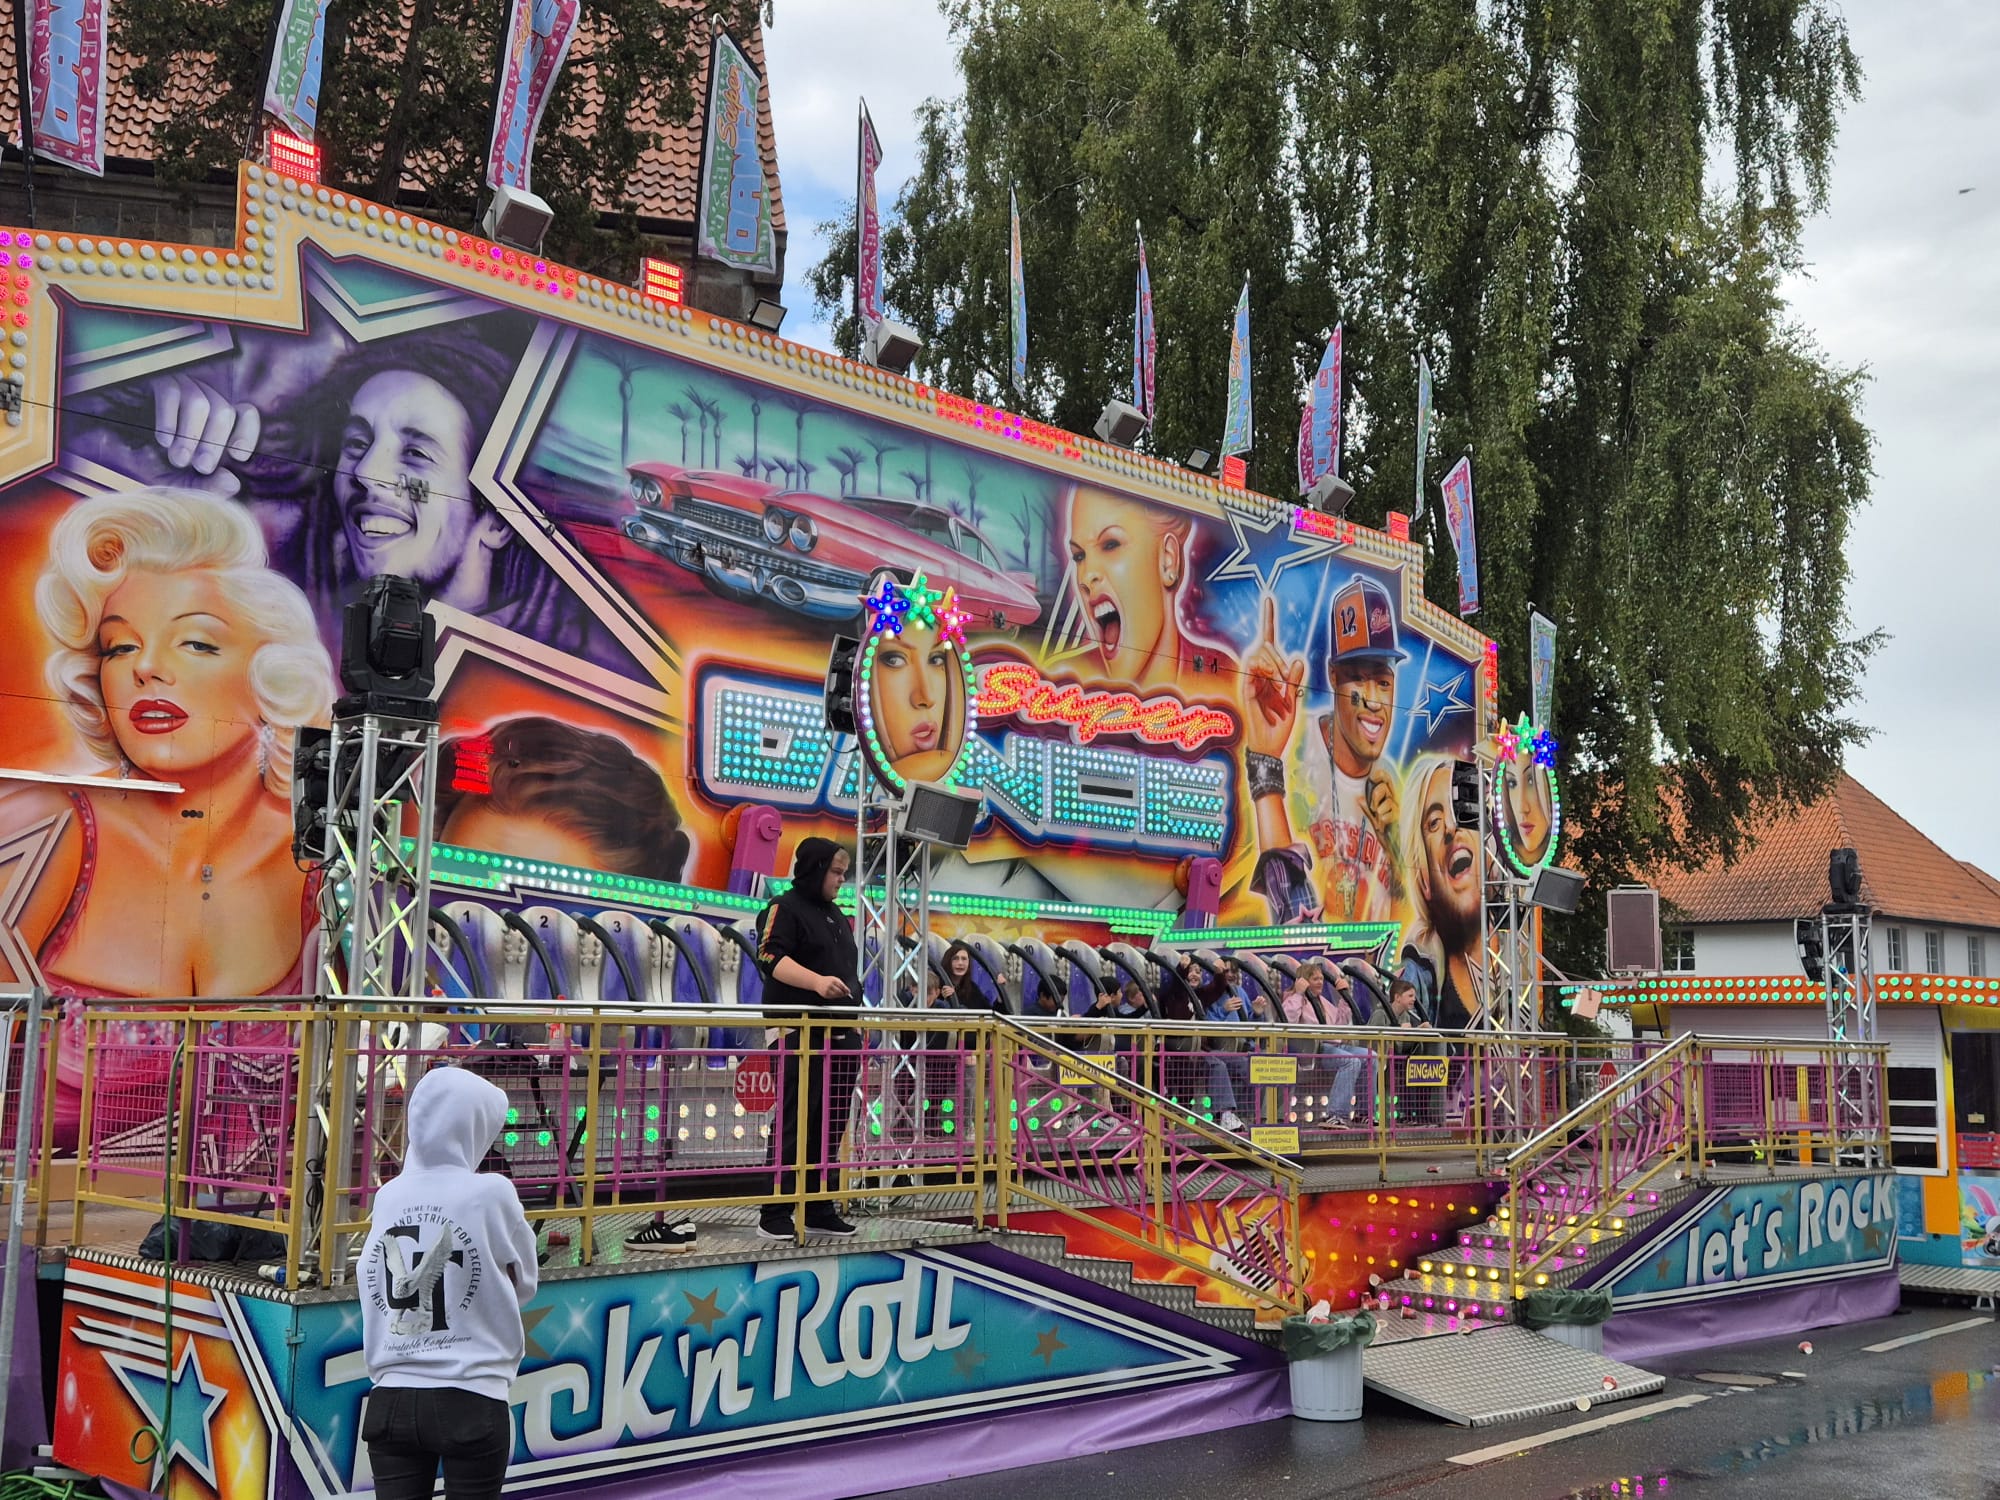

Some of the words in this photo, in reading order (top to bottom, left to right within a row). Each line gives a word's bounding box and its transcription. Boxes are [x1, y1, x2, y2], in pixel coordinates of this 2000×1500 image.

[1341, 606, 1357, 635] 12
[974, 662, 1235, 748] Super
[712, 688, 1227, 842] DNCE
[463, 911, 470, 923] 1
[540, 915, 549, 929] 2
[613, 920, 622, 933] 3
[683, 923, 692, 936] 4
[749, 928, 756, 941] 5
[1024, 944, 1034, 956] 10
[1408, 1063, 1445, 1080] EINGANG
[403, 1205, 423, 1215] CRIME
[427, 1204, 443, 1213] TIME
[453, 1226, 472, 1246] FOR
[367, 1268, 376, 1290] THE
[459, 1247, 481, 1312] EXCELLENCE
[371, 1291, 389, 1317] PUSH
[424, 1335, 472, 1348] Confidence
